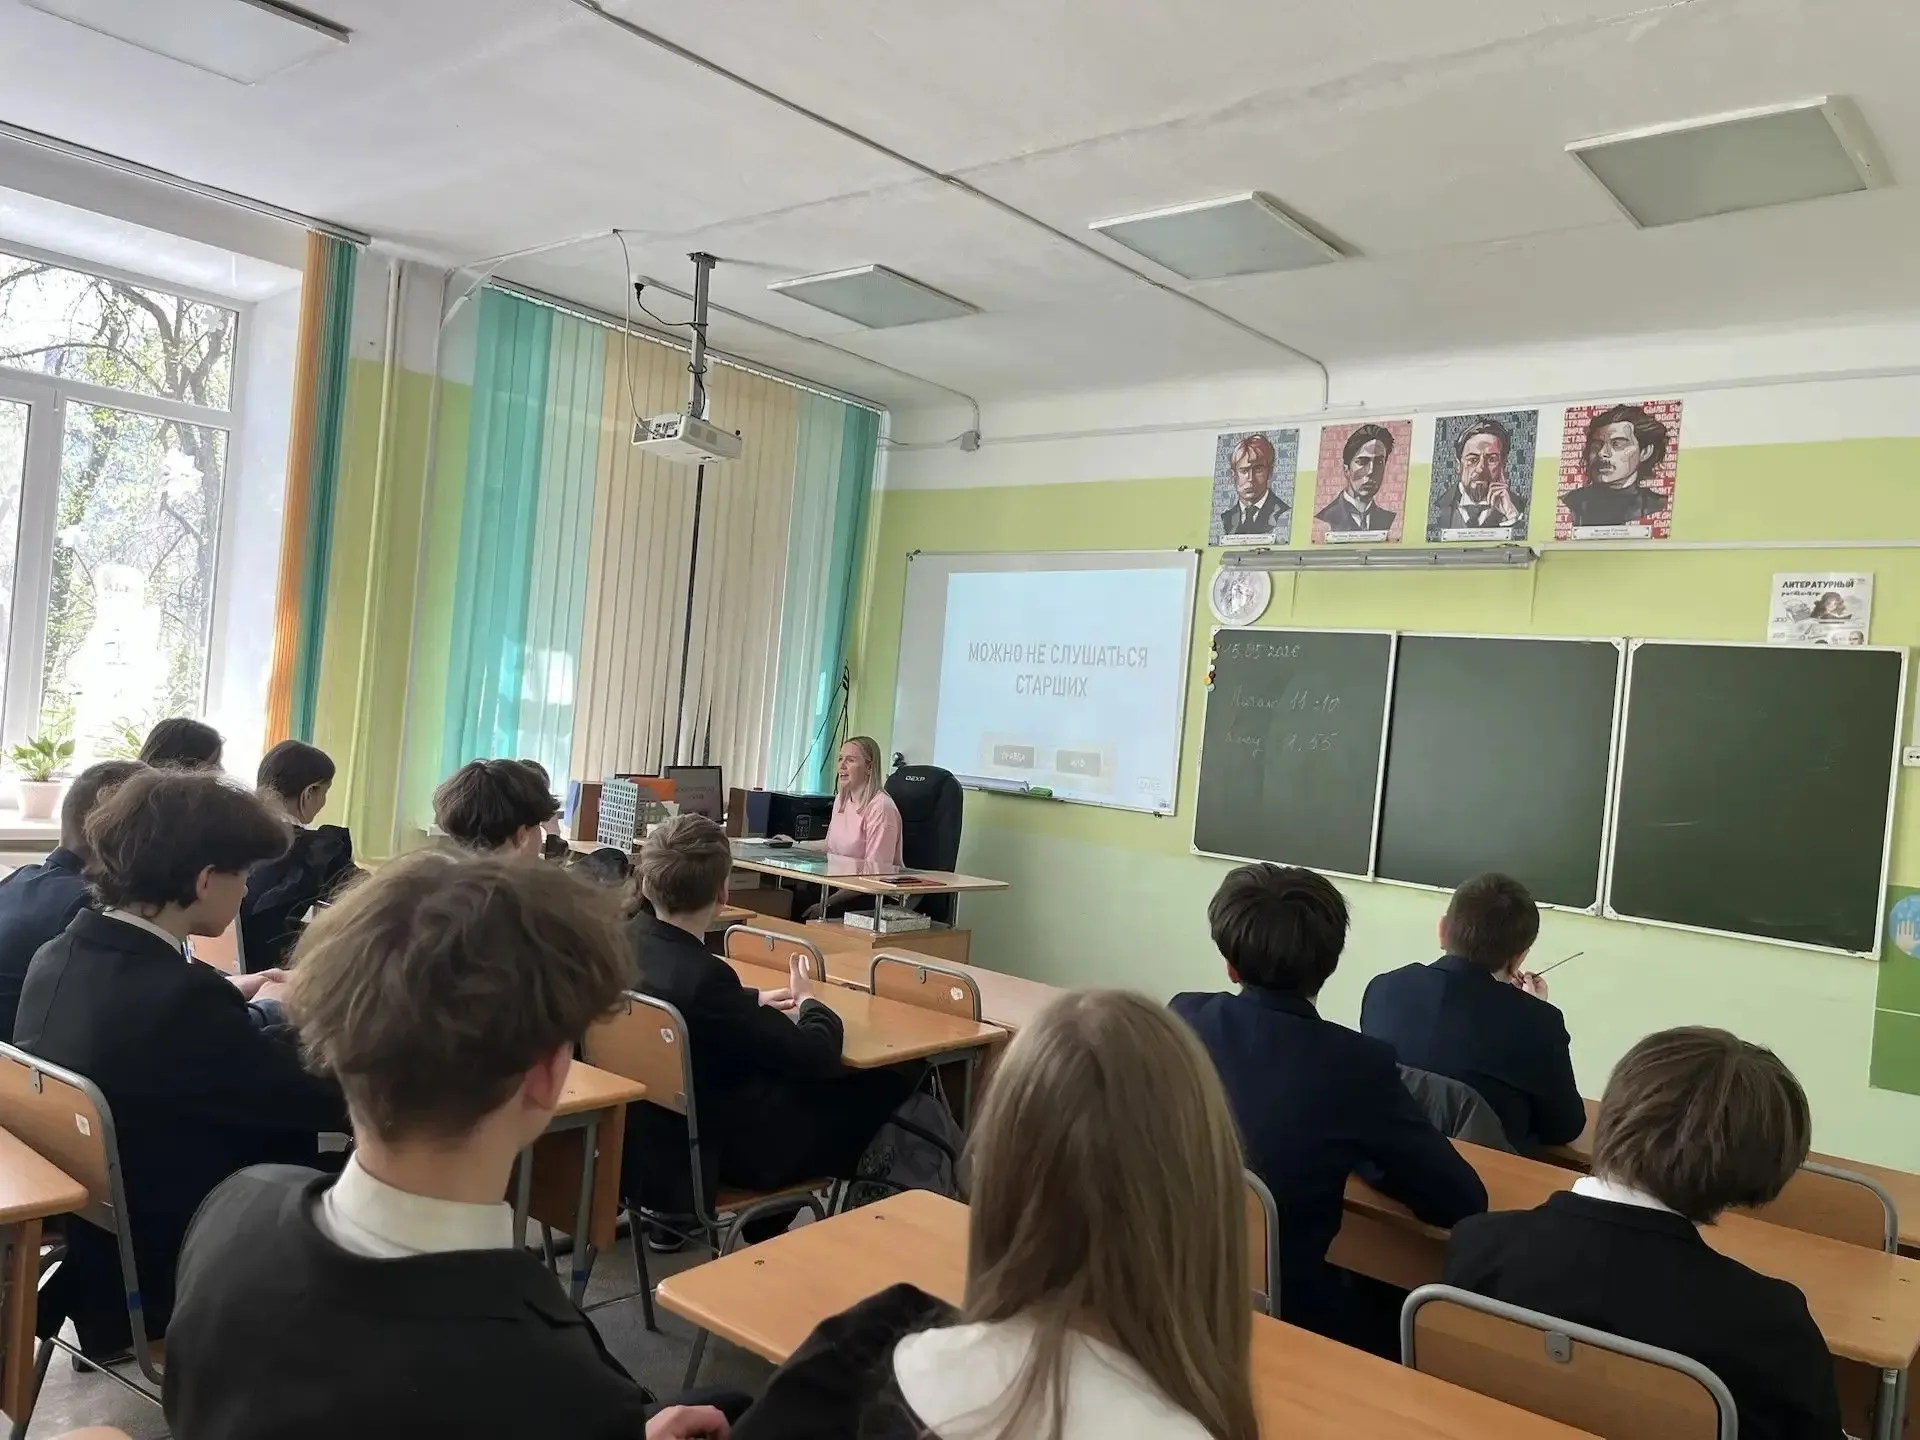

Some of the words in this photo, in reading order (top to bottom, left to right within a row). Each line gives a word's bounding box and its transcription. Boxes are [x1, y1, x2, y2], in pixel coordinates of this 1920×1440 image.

[1782, 579, 1854, 589] ЛИТЕРАТУРНЫЙ
[968, 643, 1023, 662] МОЖНО
[1026, 645, 1046, 664] НЕ
[1050, 645, 1149, 667] СЛУШАТЬСЯ
[1015, 674, 1088, 696] СТАРШИХ
